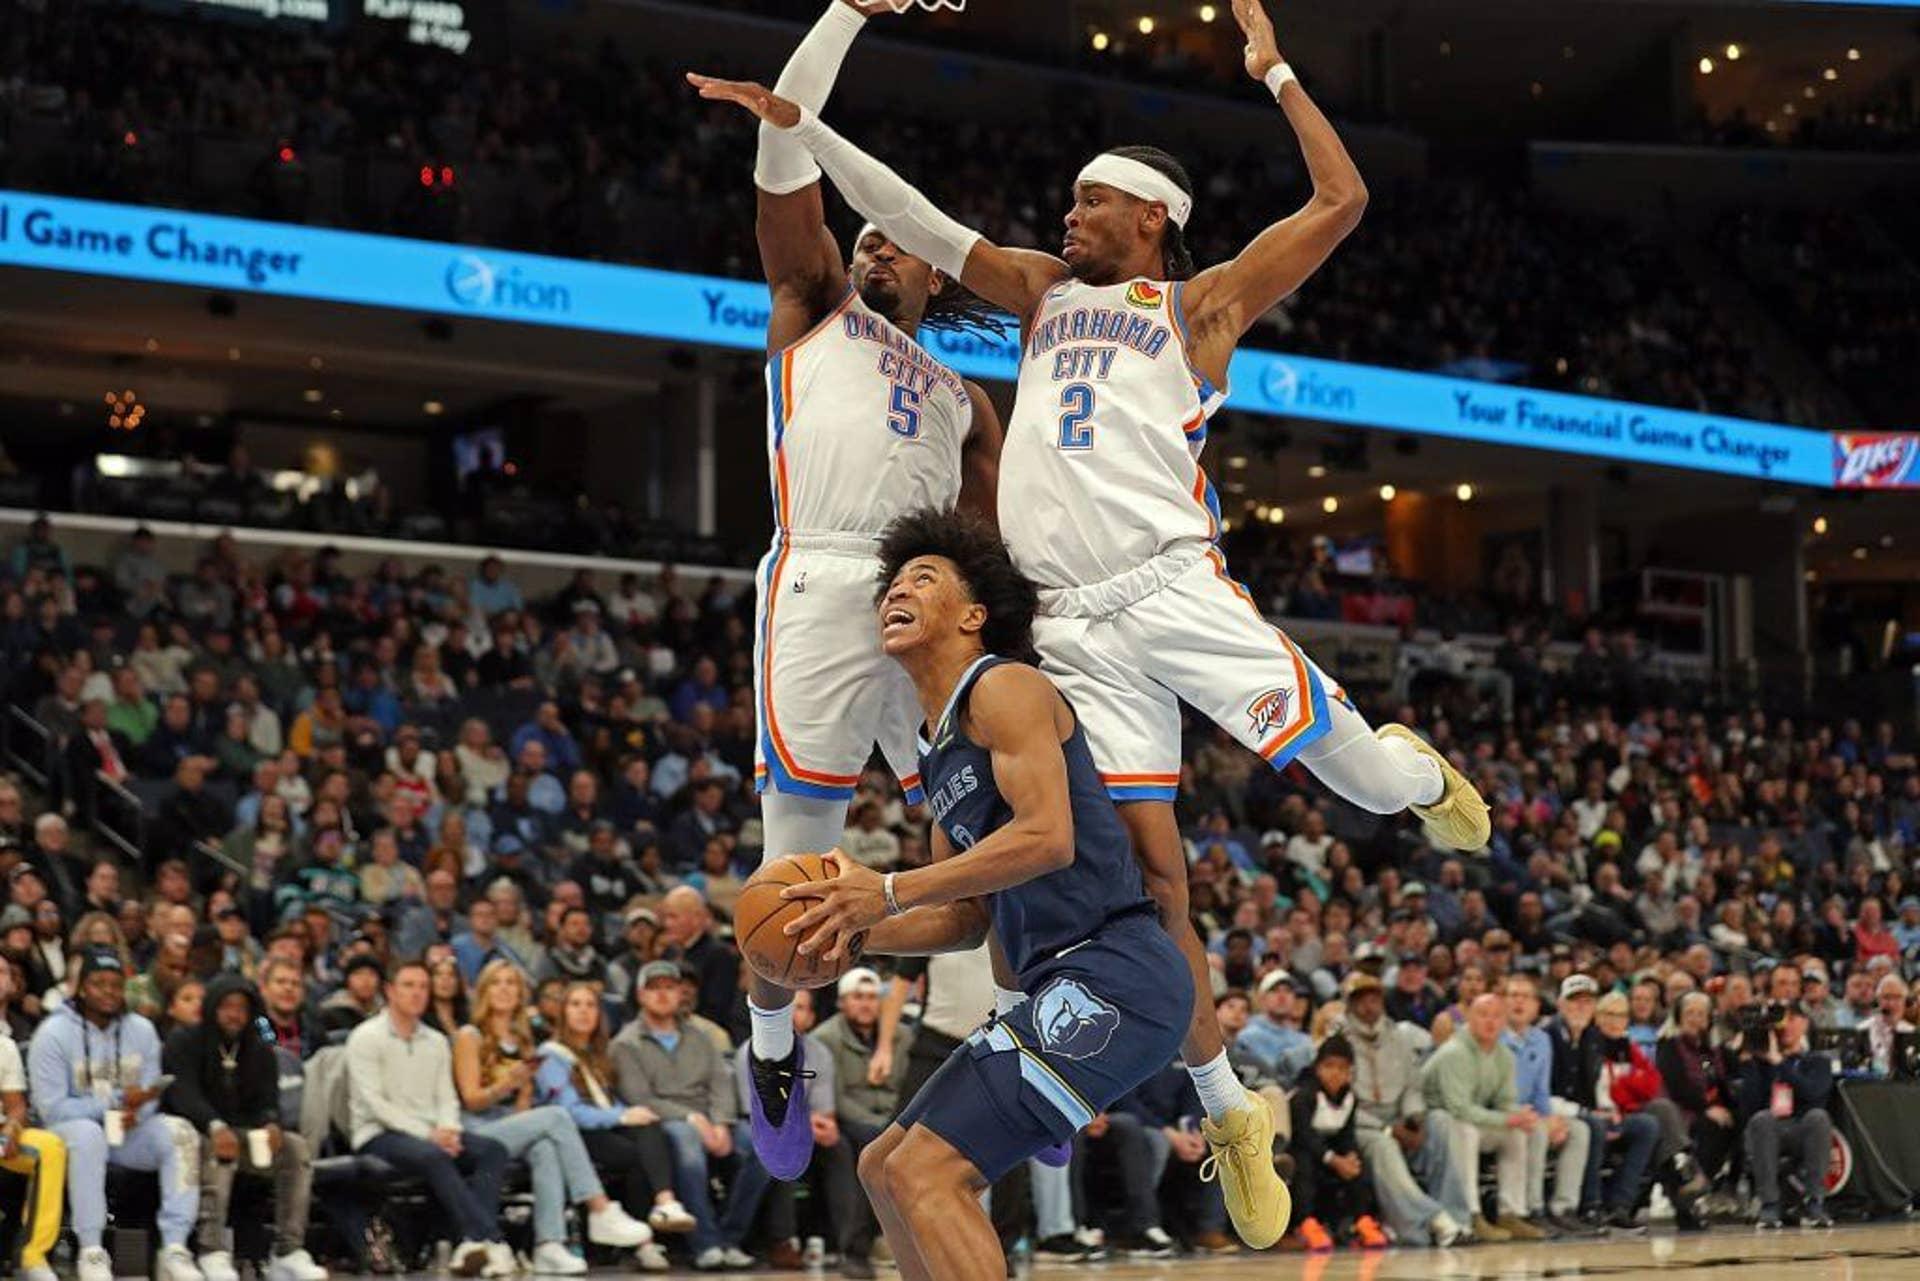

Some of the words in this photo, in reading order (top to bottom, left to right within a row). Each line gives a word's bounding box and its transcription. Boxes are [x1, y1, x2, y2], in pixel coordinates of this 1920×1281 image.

[23, 208, 134, 256] Game
[146, 222, 302, 283] Changer
[445, 254, 569, 313] Orion
[1031, 308, 1171, 360] OKLAHOMA
[1052, 347, 1118, 381] CITY
[878, 350, 939, 399] CITY
[886, 380, 923, 441] 5
[1057, 382, 1096, 451] 2
[1453, 389, 1506, 425] Your
[1516, 398, 1623, 441] Financial
[1628, 414, 1694, 450] Game
[1701, 426, 1791, 474] Changer
